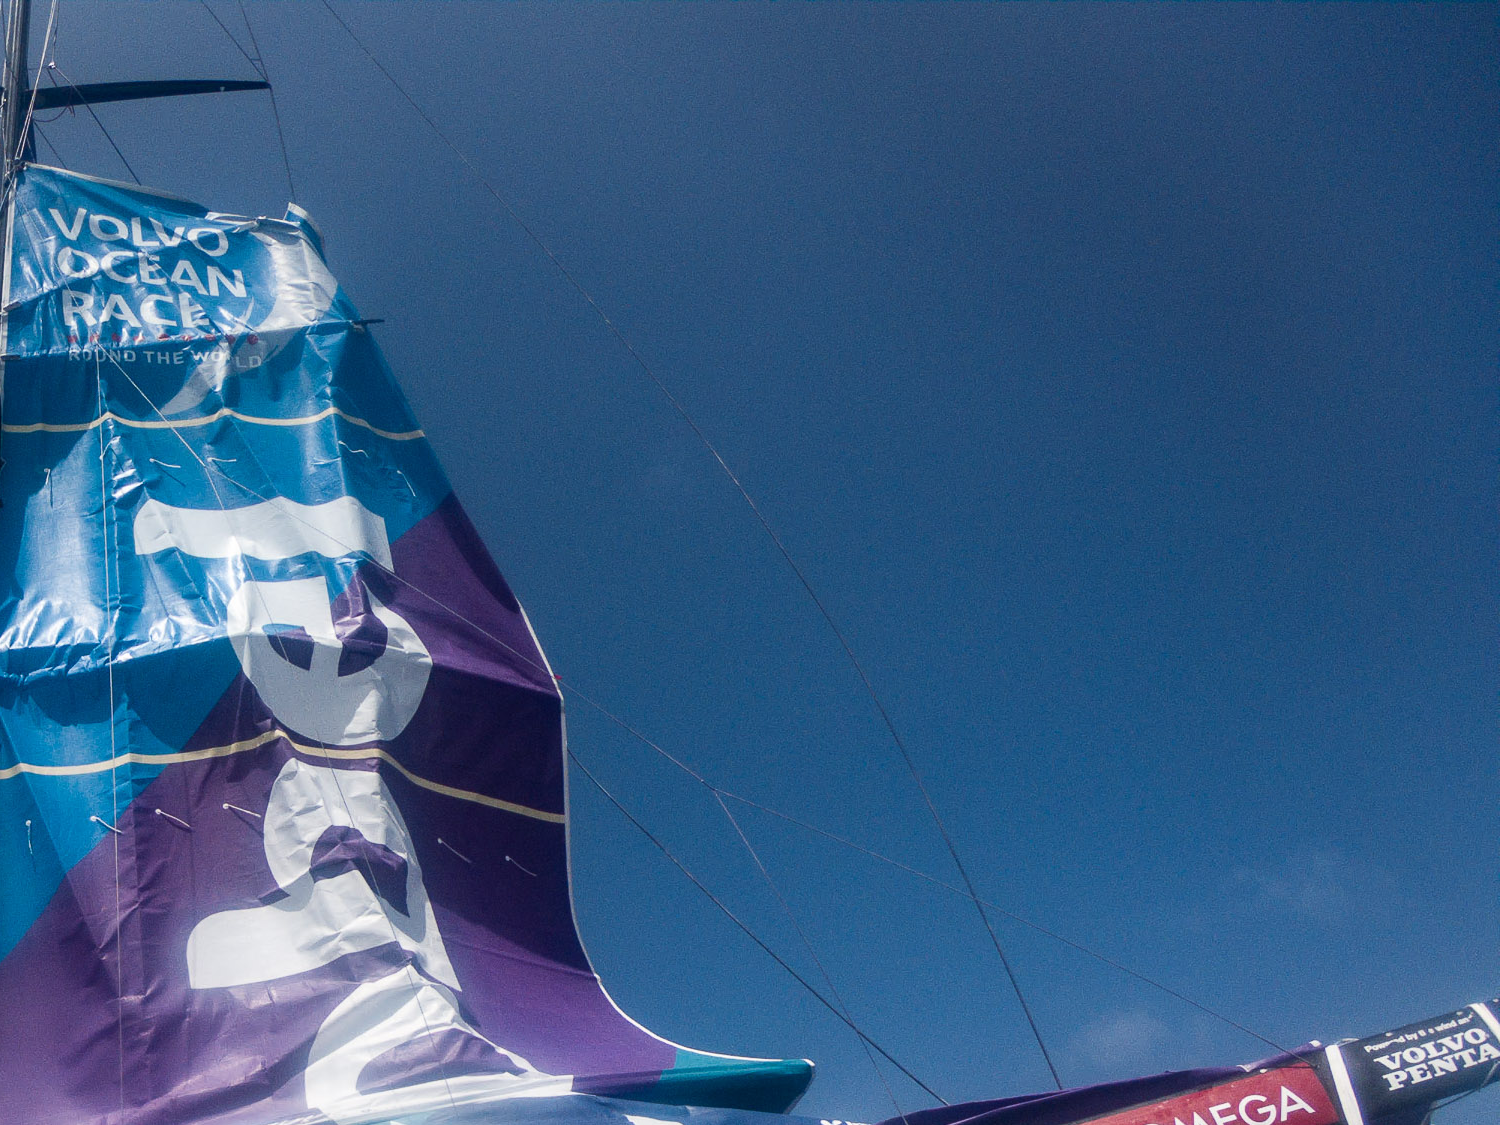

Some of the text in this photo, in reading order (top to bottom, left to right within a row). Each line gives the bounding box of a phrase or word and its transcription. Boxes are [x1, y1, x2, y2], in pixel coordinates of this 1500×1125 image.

[48, 207, 228, 257] VOLVO
[57, 246, 247, 298] OCEAN
[62, 289, 211, 329] RACE
[68, 349, 136, 363] ROUND
[142, 351, 184, 365] THE
[1373, 1028, 1487, 1071] VOLVO
[1404, 1032, 1419, 1042] by
[1434, 1020, 1458, 1032] wind
[1381, 1043, 1500, 1091] PENTA
